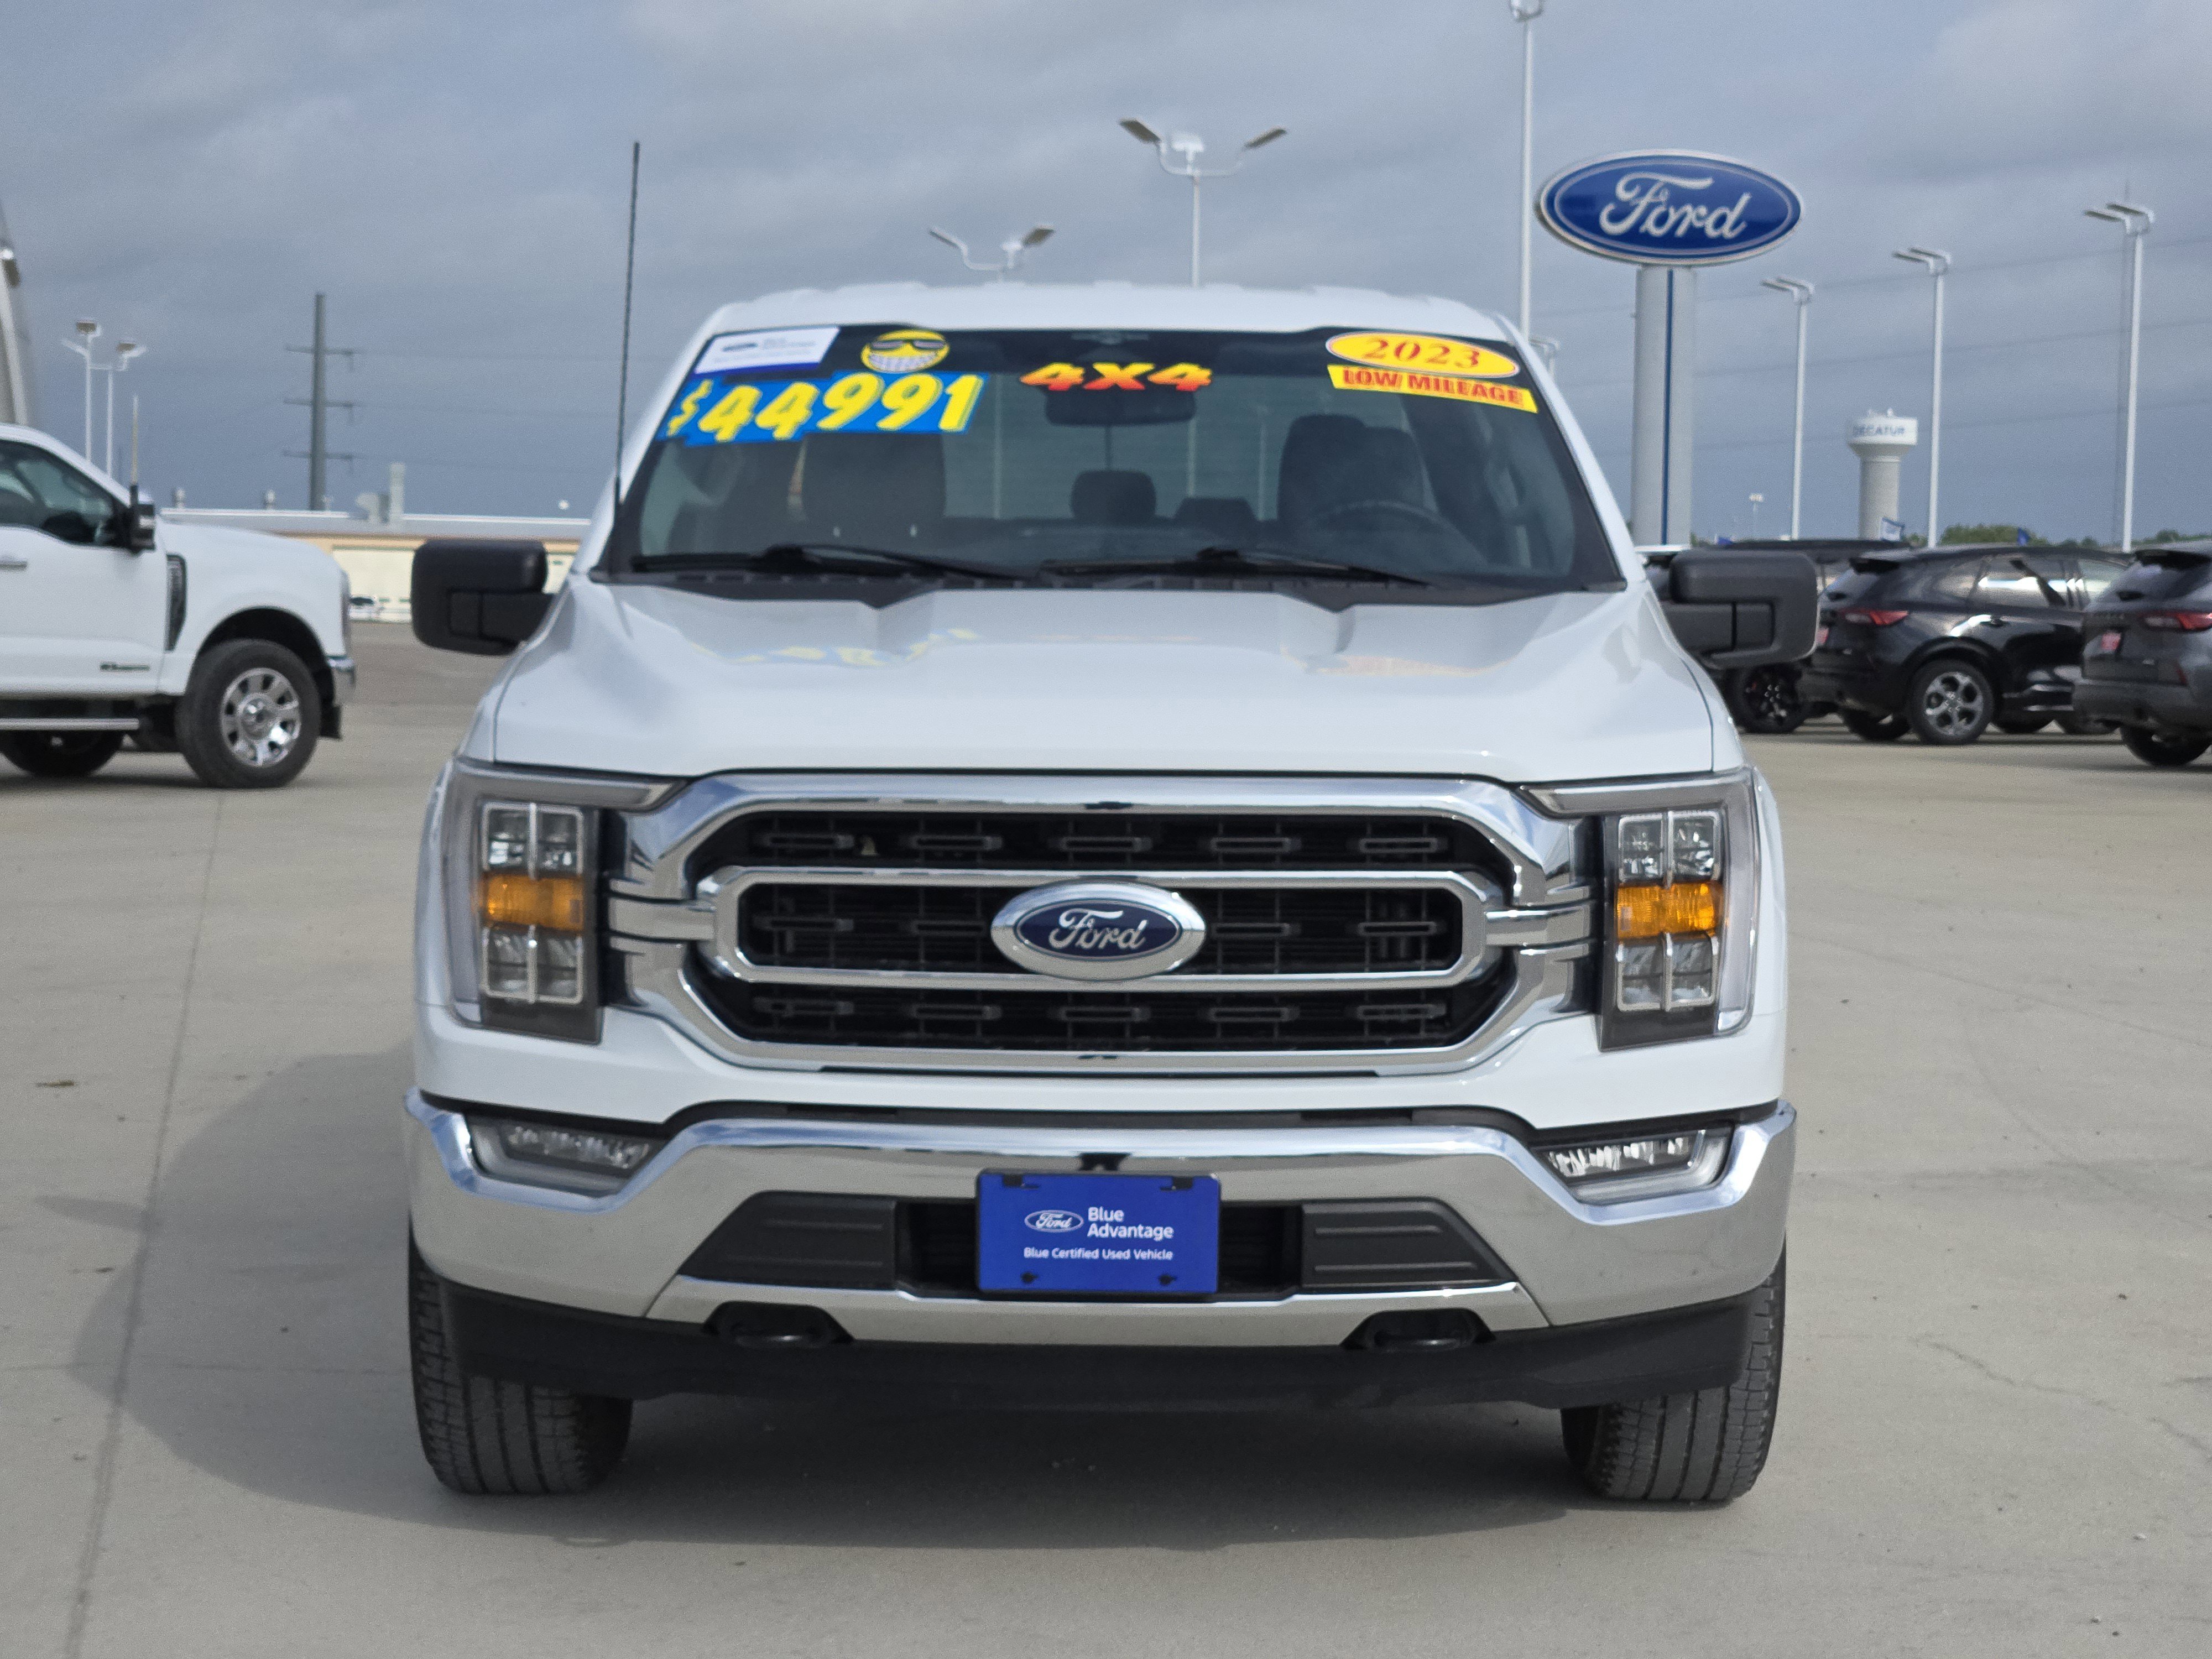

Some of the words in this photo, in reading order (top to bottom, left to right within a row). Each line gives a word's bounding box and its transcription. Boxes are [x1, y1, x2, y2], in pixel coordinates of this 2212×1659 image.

[1599, 171, 1752, 239] Ford
[1363, 337, 1480, 368] 2023
[1343, 369, 1400, 387] LOW
[1408, 374, 1523, 406] MILEAGE
[666, 372, 984, 442] $44991
[1048, 907, 1149, 951] Ford
[1036, 1212, 1072, 1229] Ford
[1088, 1207, 1124, 1222] Blue
[1087, 1223, 1174, 1241] Advantage
[1024, 1246, 1049, 1259] Blue
[1052, 1247, 1099, 1259] Certified
[1102, 1248, 1130, 1260] Used
[1134, 1249, 1173, 1260] Vehicle
